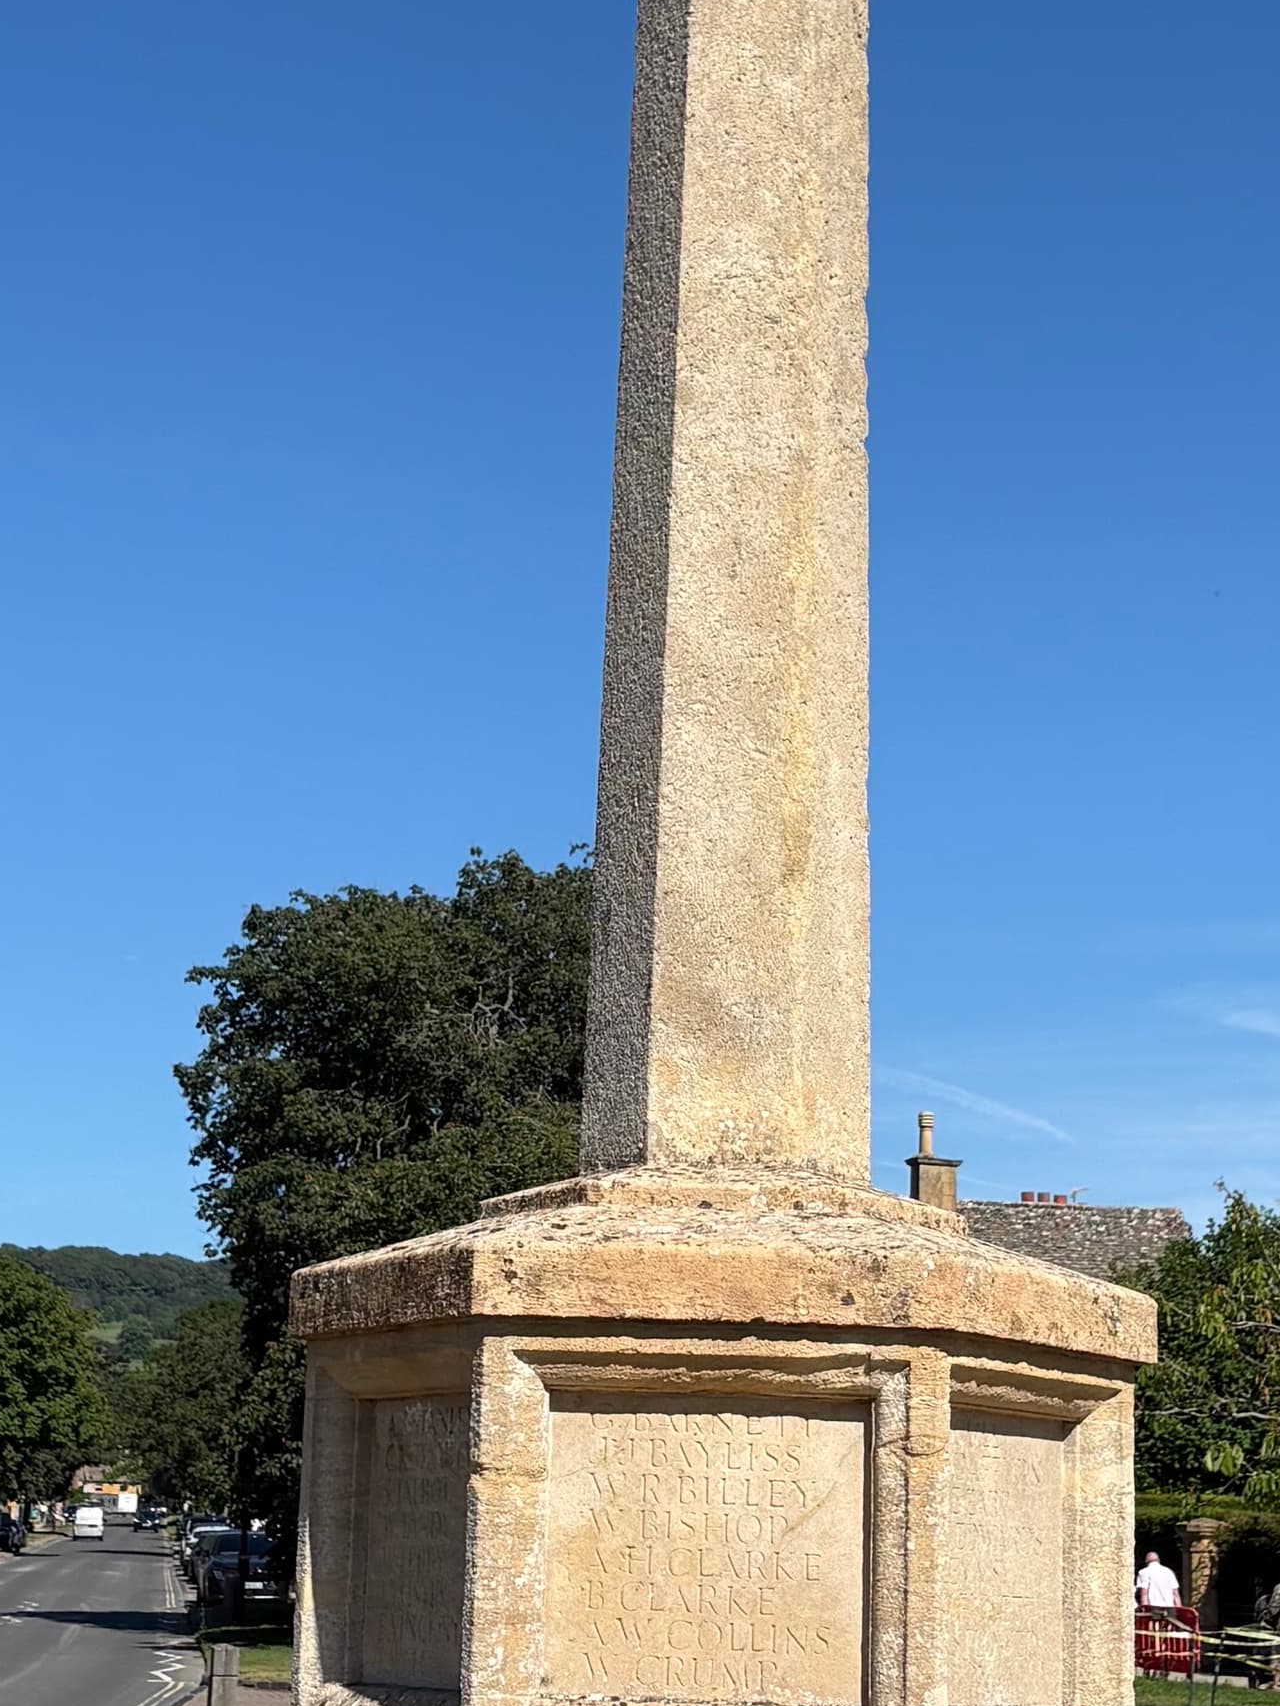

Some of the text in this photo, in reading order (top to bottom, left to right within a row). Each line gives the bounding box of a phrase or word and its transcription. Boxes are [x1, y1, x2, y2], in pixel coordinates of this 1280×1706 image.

[649, 1438, 802, 1474] BAYLISS
[640, 1473, 661, 1504] R
[677, 1474, 817, 1509] BILLEY
[638, 1509, 789, 1545] BISHOP
[668, 1547, 822, 1582] CLARKE
[586, 1580, 776, 1616] B CLARKE
[667, 1619, 831, 1654] COLLINS
[634, 1654, 778, 1692] CRUMP
